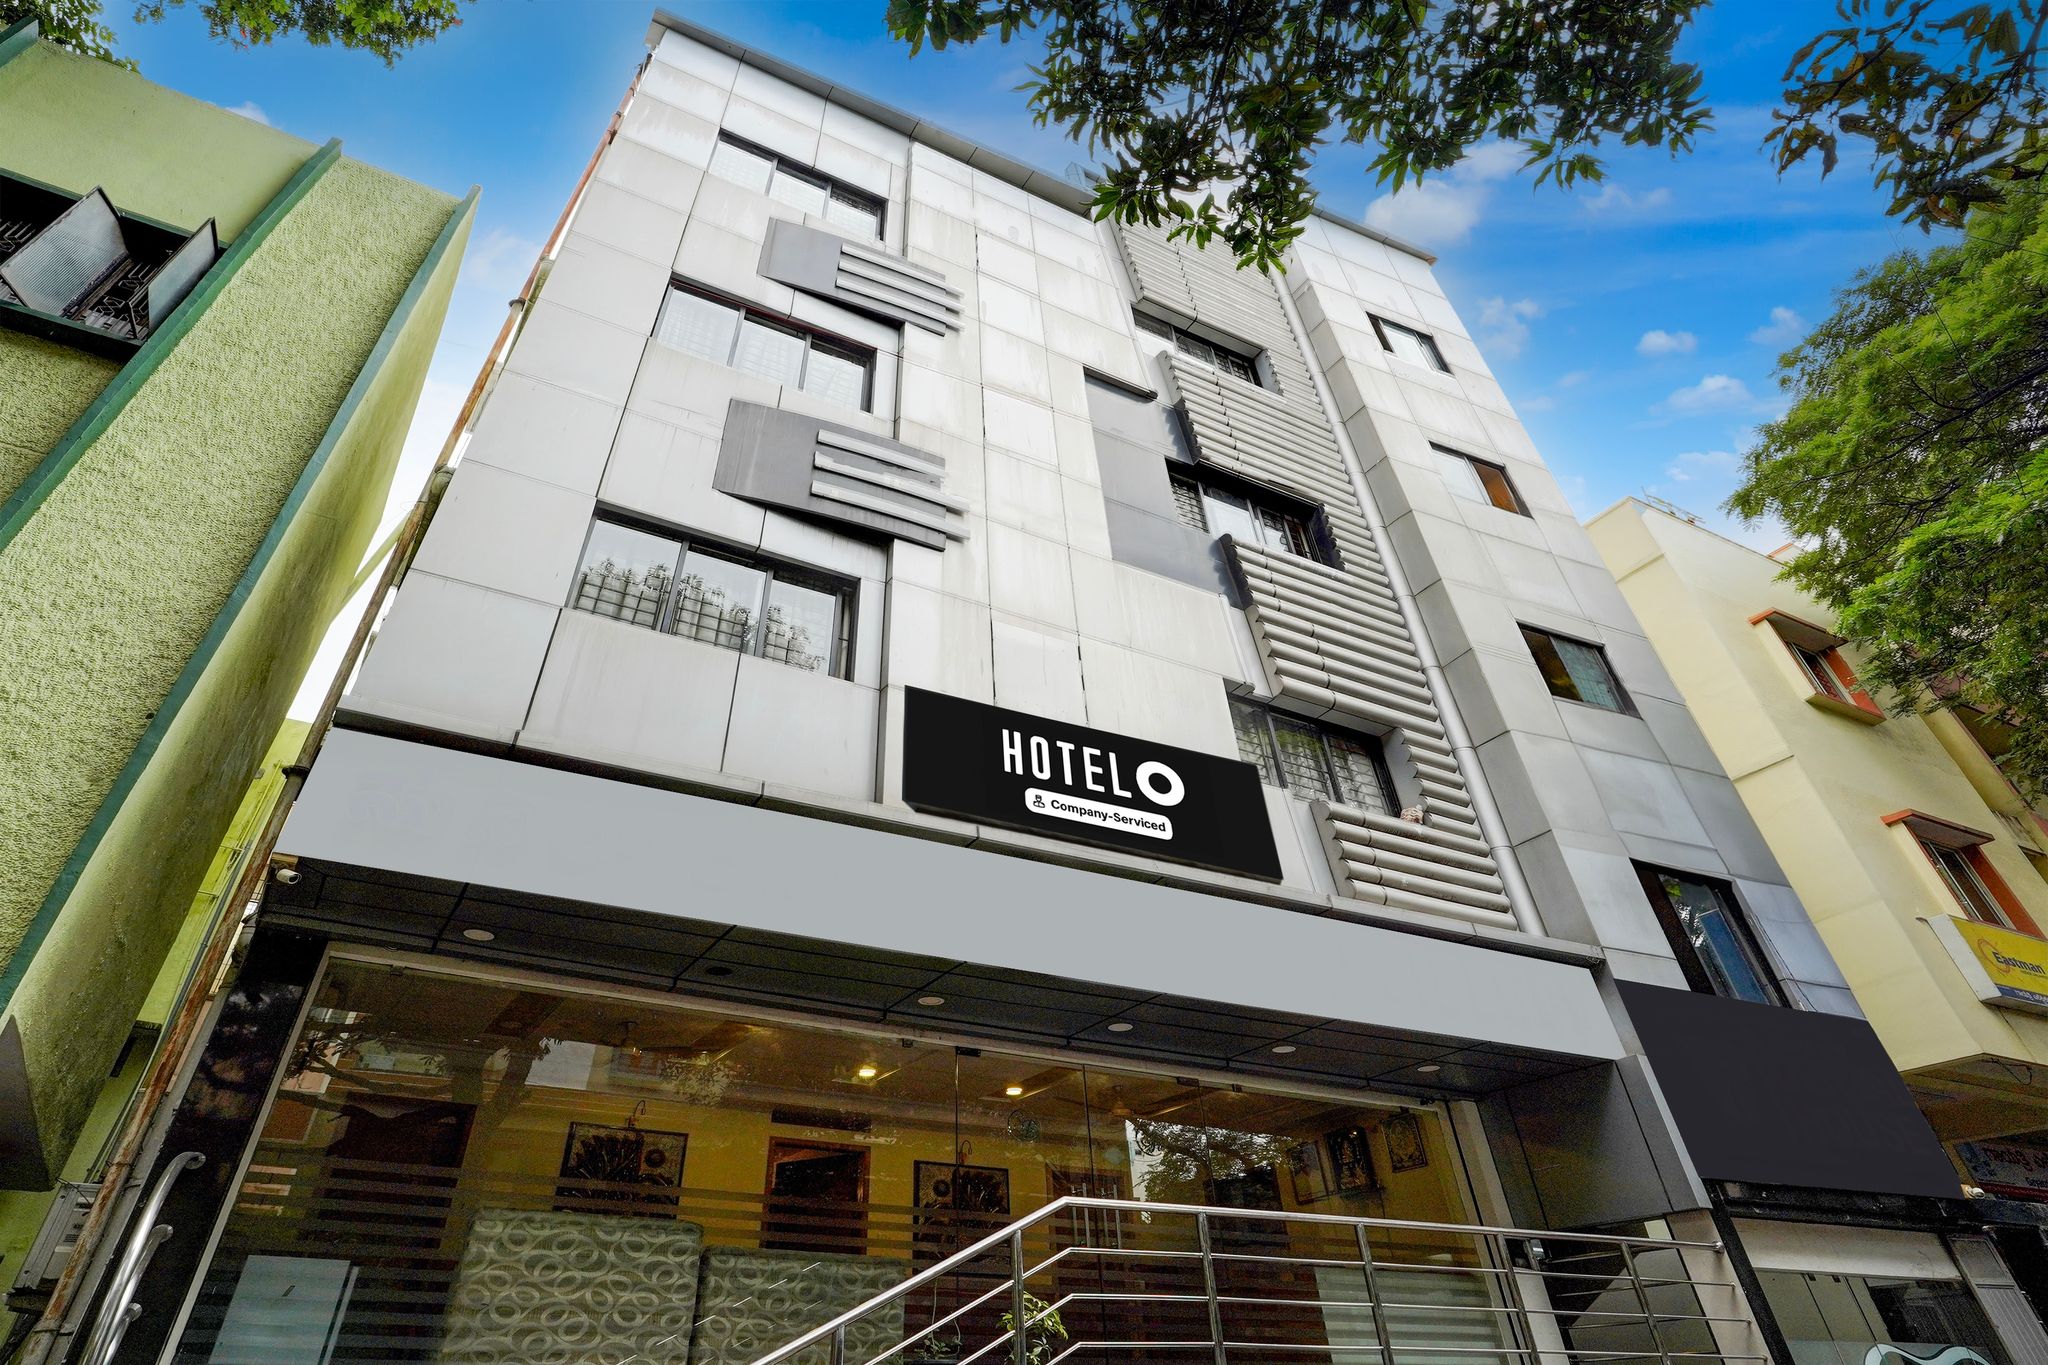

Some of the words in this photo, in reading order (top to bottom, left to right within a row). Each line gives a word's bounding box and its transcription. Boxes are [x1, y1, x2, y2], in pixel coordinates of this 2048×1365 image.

[1002, 728, 1132, 798] HOTEL
[1136, 760, 1185, 807] O
[1051, 800, 1166, 832] Company-Serviced
[1992, 951, 2046, 974] Eastman
